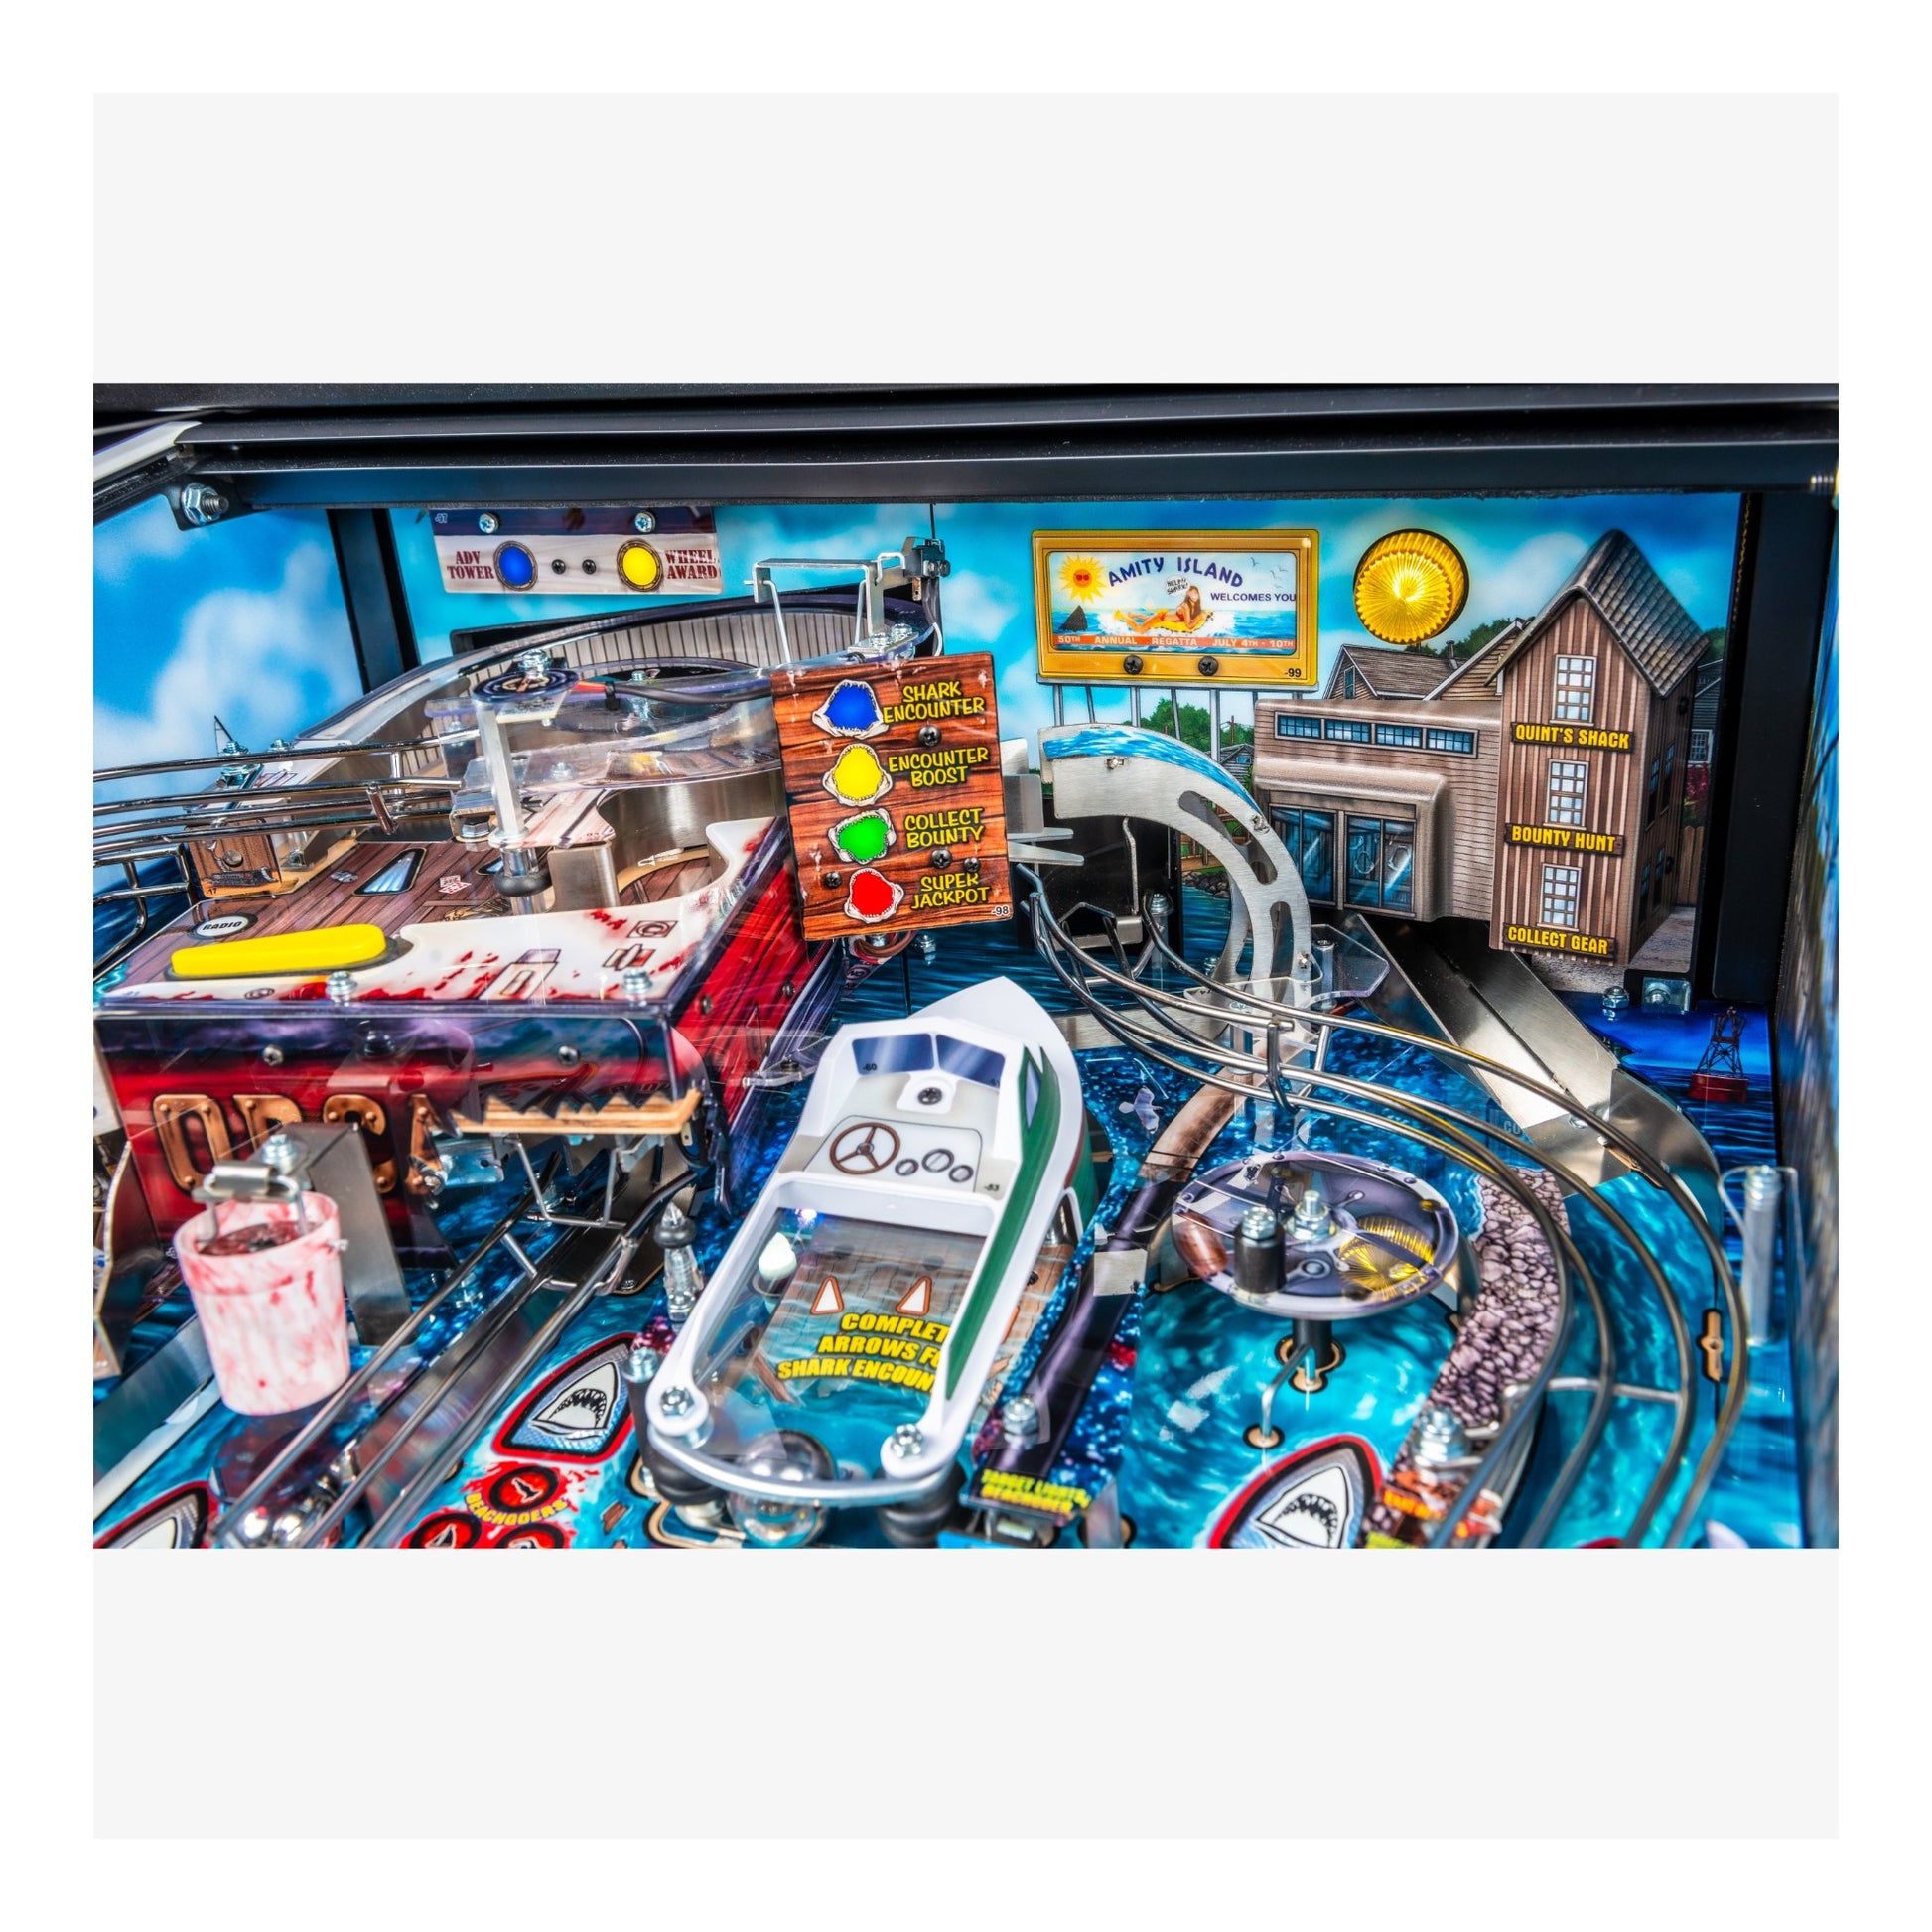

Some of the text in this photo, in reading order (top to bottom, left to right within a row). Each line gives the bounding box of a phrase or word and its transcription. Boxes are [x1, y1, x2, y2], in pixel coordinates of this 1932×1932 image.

[455, 551, 480, 565] ADV
[664, 549, 716, 564] WHEEL
[447, 564, 494, 580] TOWER
[667, 564, 718, 580] AWARD
[1107, 556, 1244, 588] AMITY ISLAND
[1209, 592, 1297, 603] WELCOMES YOU
[1057, 635, 1081, 644] 50TH
[1094, 635, 1138, 645] ANNUAL
[1151, 636, 1198, 646] REGATTA
[1211, 638, 1238, 647] JULY
[1240, 638, 1259, 647] 4TH
[1269, 639, 1295, 648] 10TH
[1283, 668, 1303, 678] -99
[902, 681, 962, 703] SHARK
[882, 696, 986, 724] ENCOUNTER
[1515, 724, 1630, 749] QUINT'S SHACK
[888, 746, 990, 773] ENCOUNTER
[910, 766, 969, 787] BOOST
[903, 807, 984, 831] COLLECT
[905, 825, 985, 849] BOUNTY
[1511, 825, 1616, 852] BOUNTY HUNT
[920, 872, 980, 892] SUPER
[911, 886, 991, 910] JACKPOT
[992, 905, 1010, 916] -98
[202, 921, 243, 931] RADIO
[1507, 926, 1609, 955] COLLECT GEAR
[818, 1335, 920, 1361] ARROWS
[777, 1358, 852, 1380] SHARK
